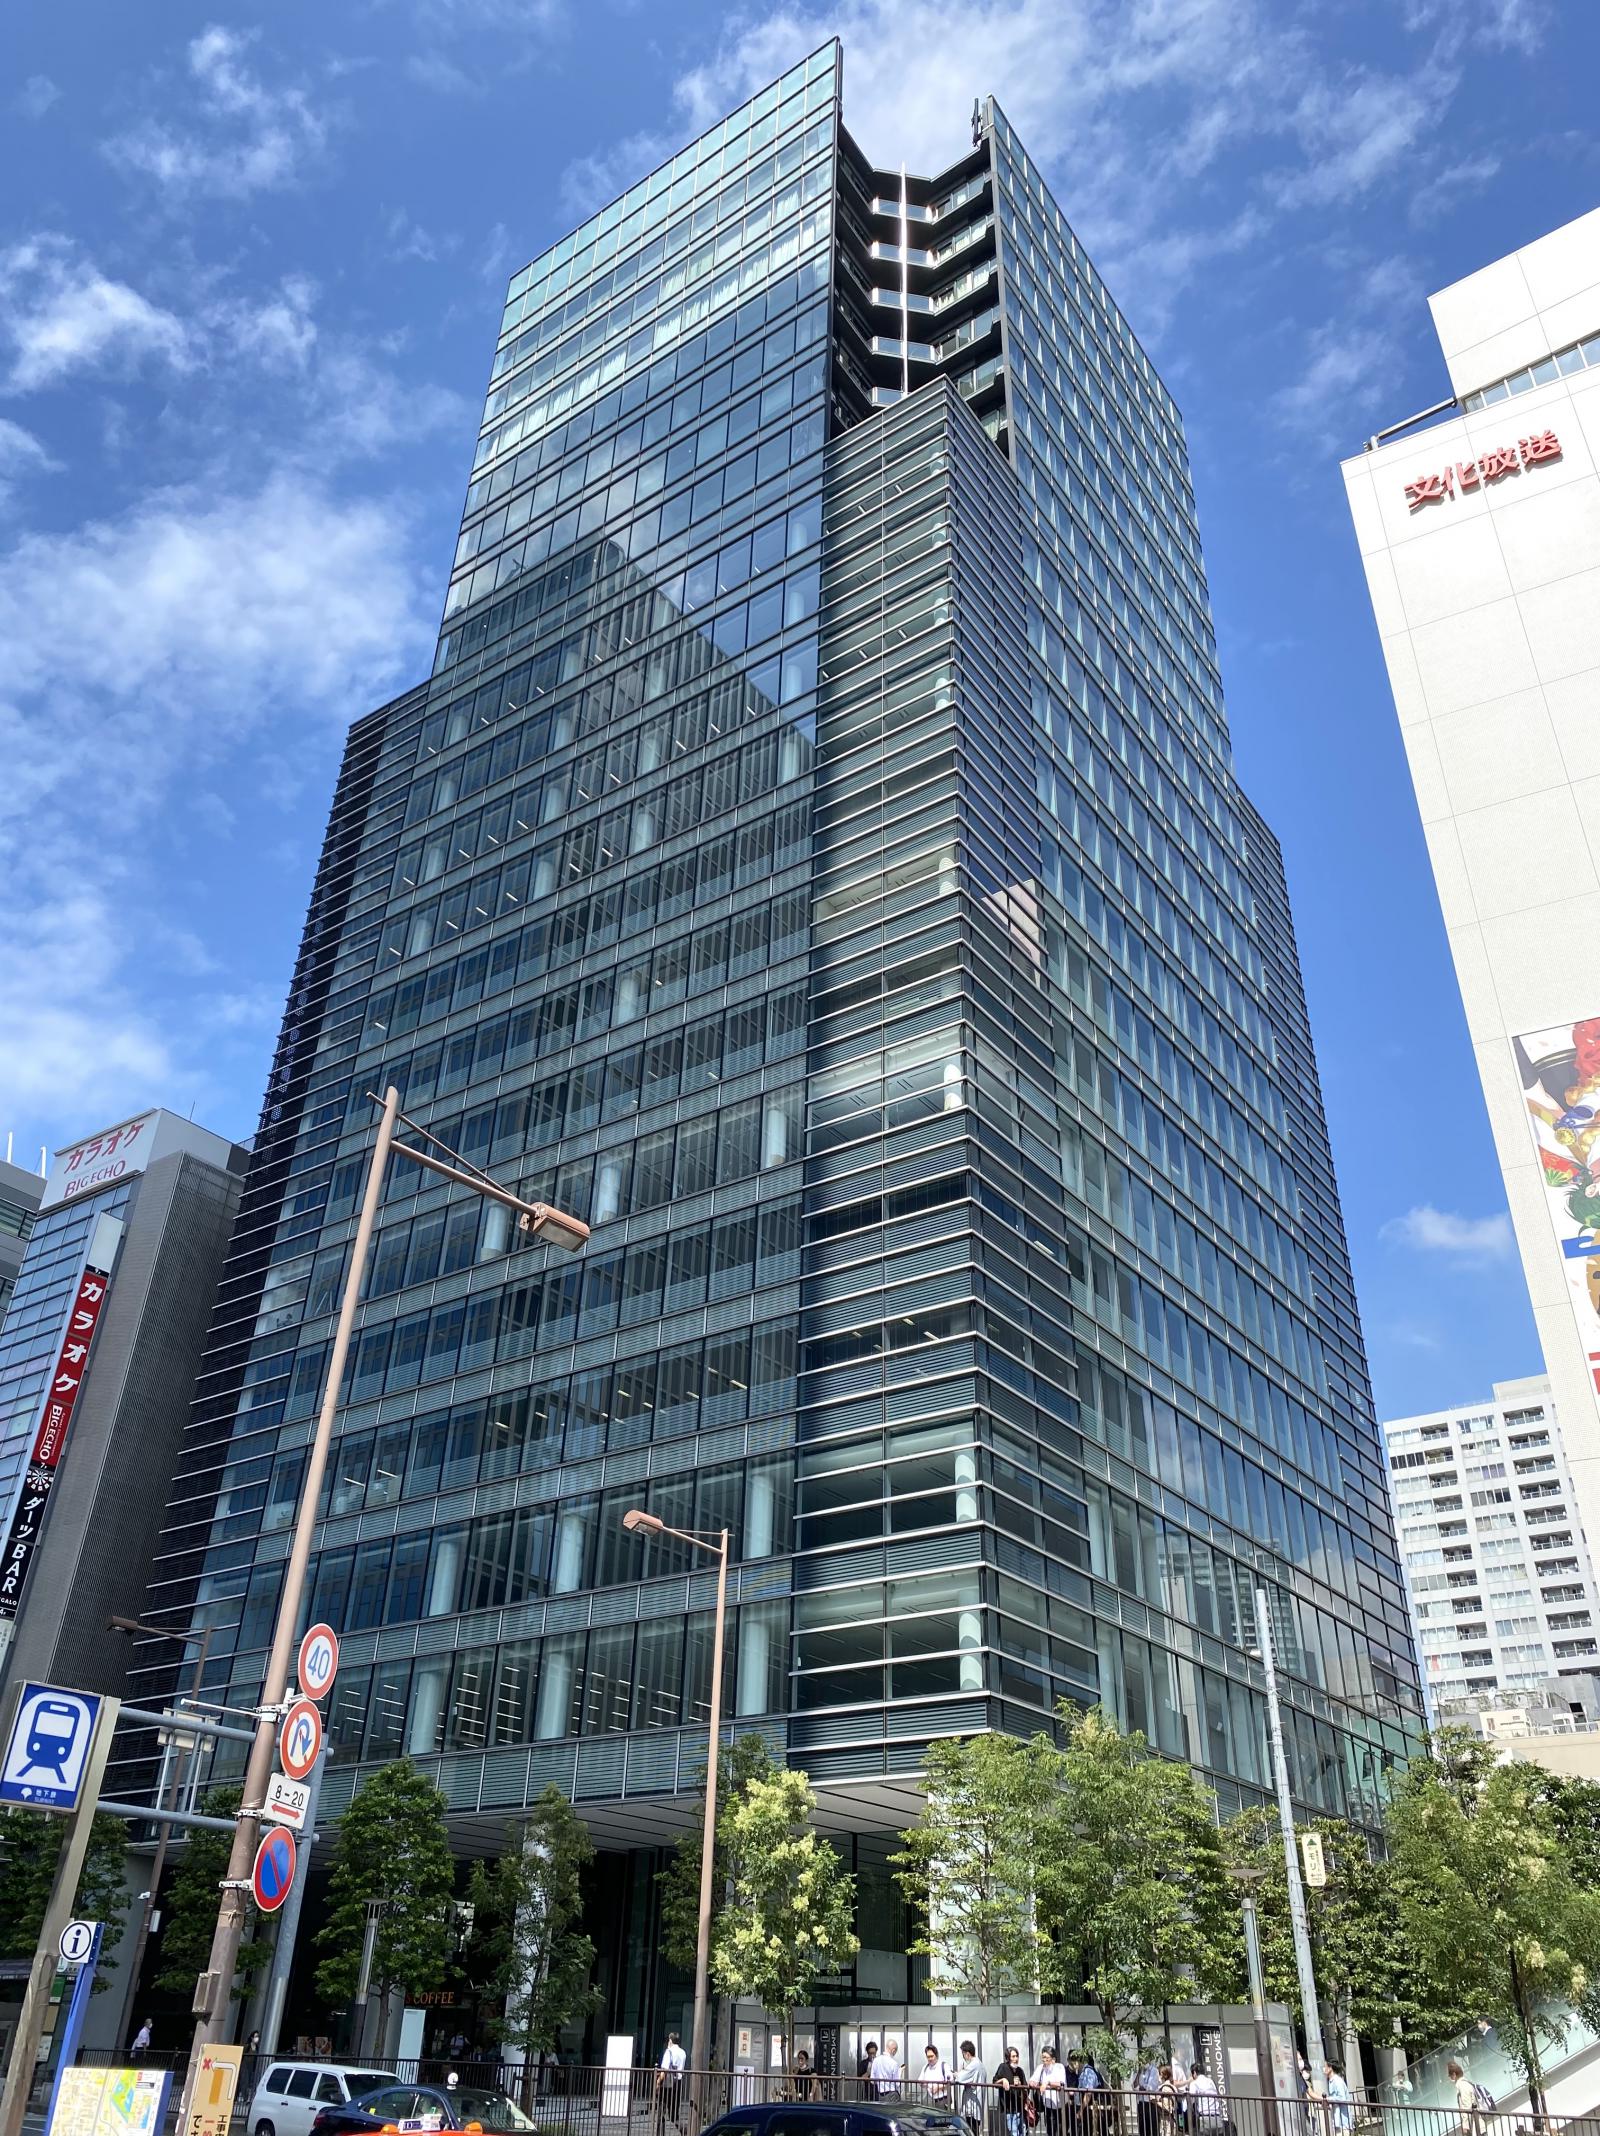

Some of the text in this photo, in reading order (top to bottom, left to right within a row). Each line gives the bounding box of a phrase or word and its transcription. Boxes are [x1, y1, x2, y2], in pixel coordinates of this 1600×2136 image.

[1403, 429, 1562, 509] 文化放送
[63, 1123, 145, 1174] カラオケ
[64, 1175, 89, 1199] BIG
[90, 1160, 126, 1183] ECHO
[54, 1281, 103, 1392] カラオケ
[50, 1404, 63, 1430] BIG
[39, 1429, 56, 1460] ECHO
[16, 1496, 45, 1539] ダーツ
[2, 1543, 27, 1594] BAR
[308, 1645, 330, 1681] 40
[275, 1784, 304, 1806] 8-20
[413, 1991, 455, 2005] COFFEE
